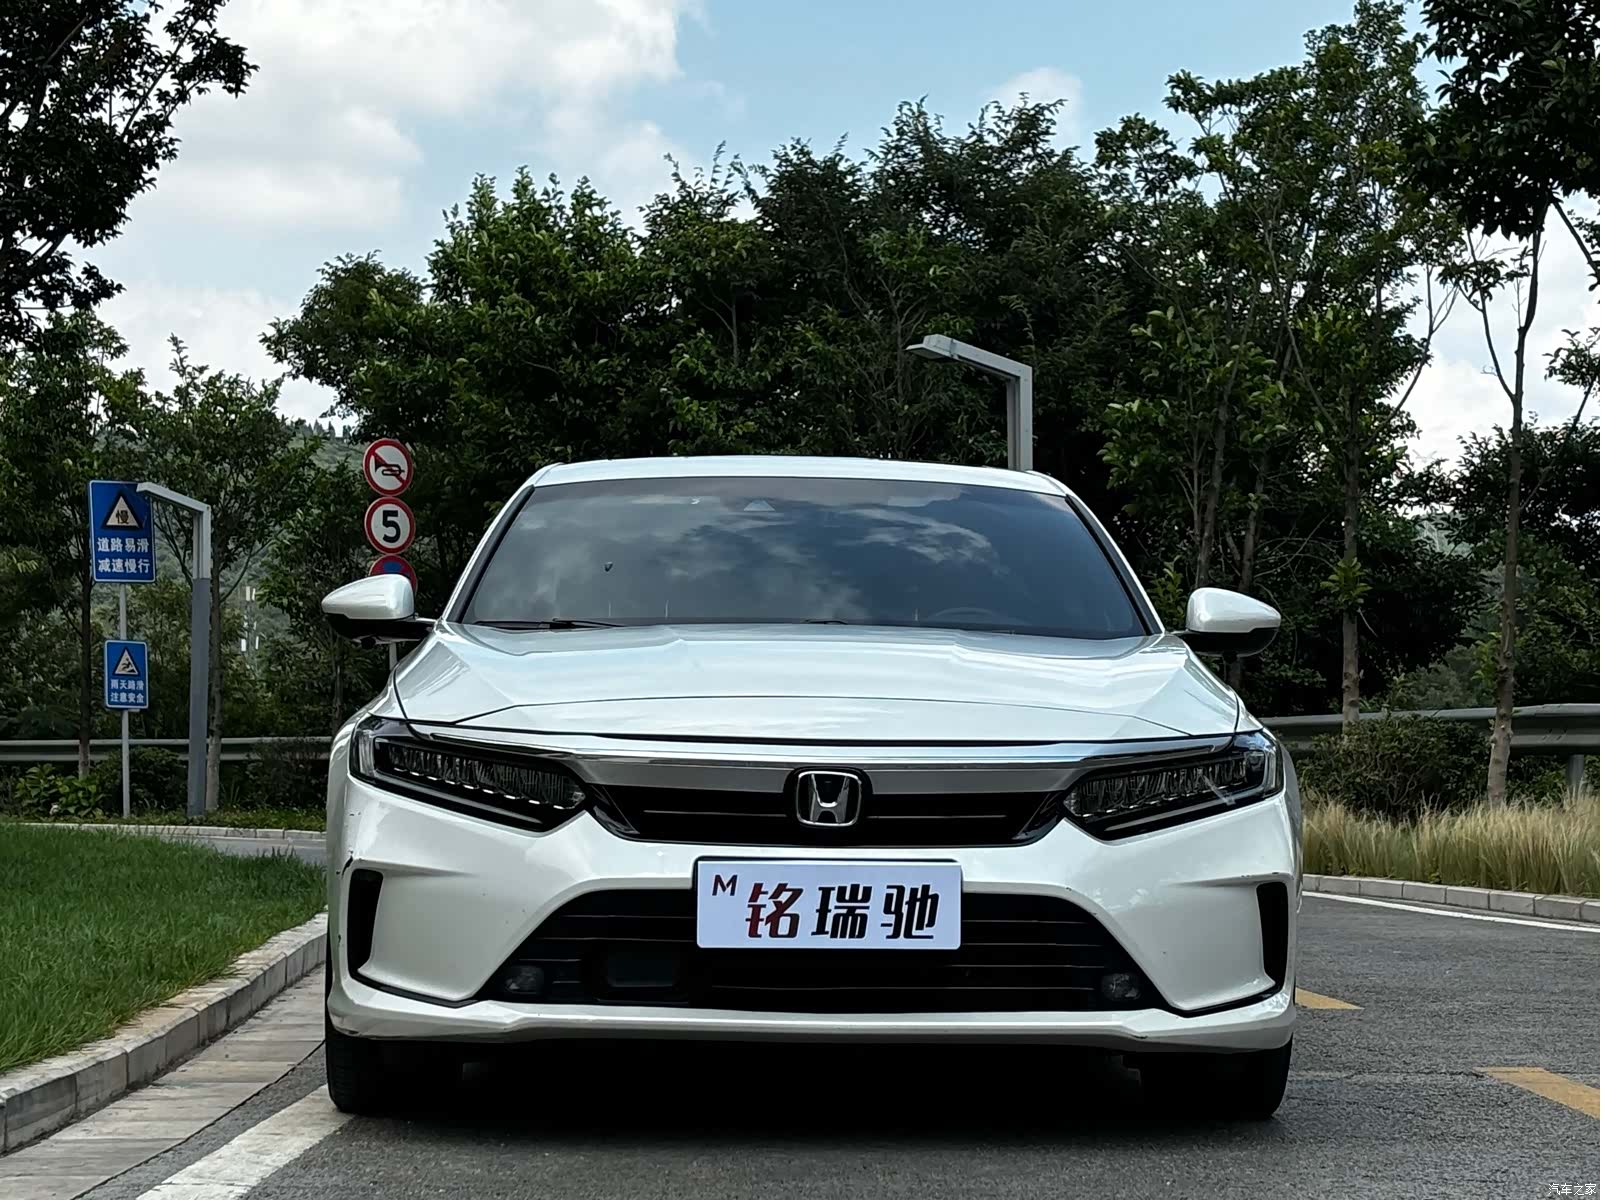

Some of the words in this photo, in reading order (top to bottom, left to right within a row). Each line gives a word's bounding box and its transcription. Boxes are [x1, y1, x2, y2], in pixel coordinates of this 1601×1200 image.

[115, 509, 129, 525] 慢
[382, 510, 401, 543] 5
[97, 537, 149, 553] 道路易滑
[98, 558, 150, 573] 减速慢行
[110, 692, 144, 703] 注意安全
[711, 874, 738, 897] M
[745, 882, 939, 940] 铭瑞驰
